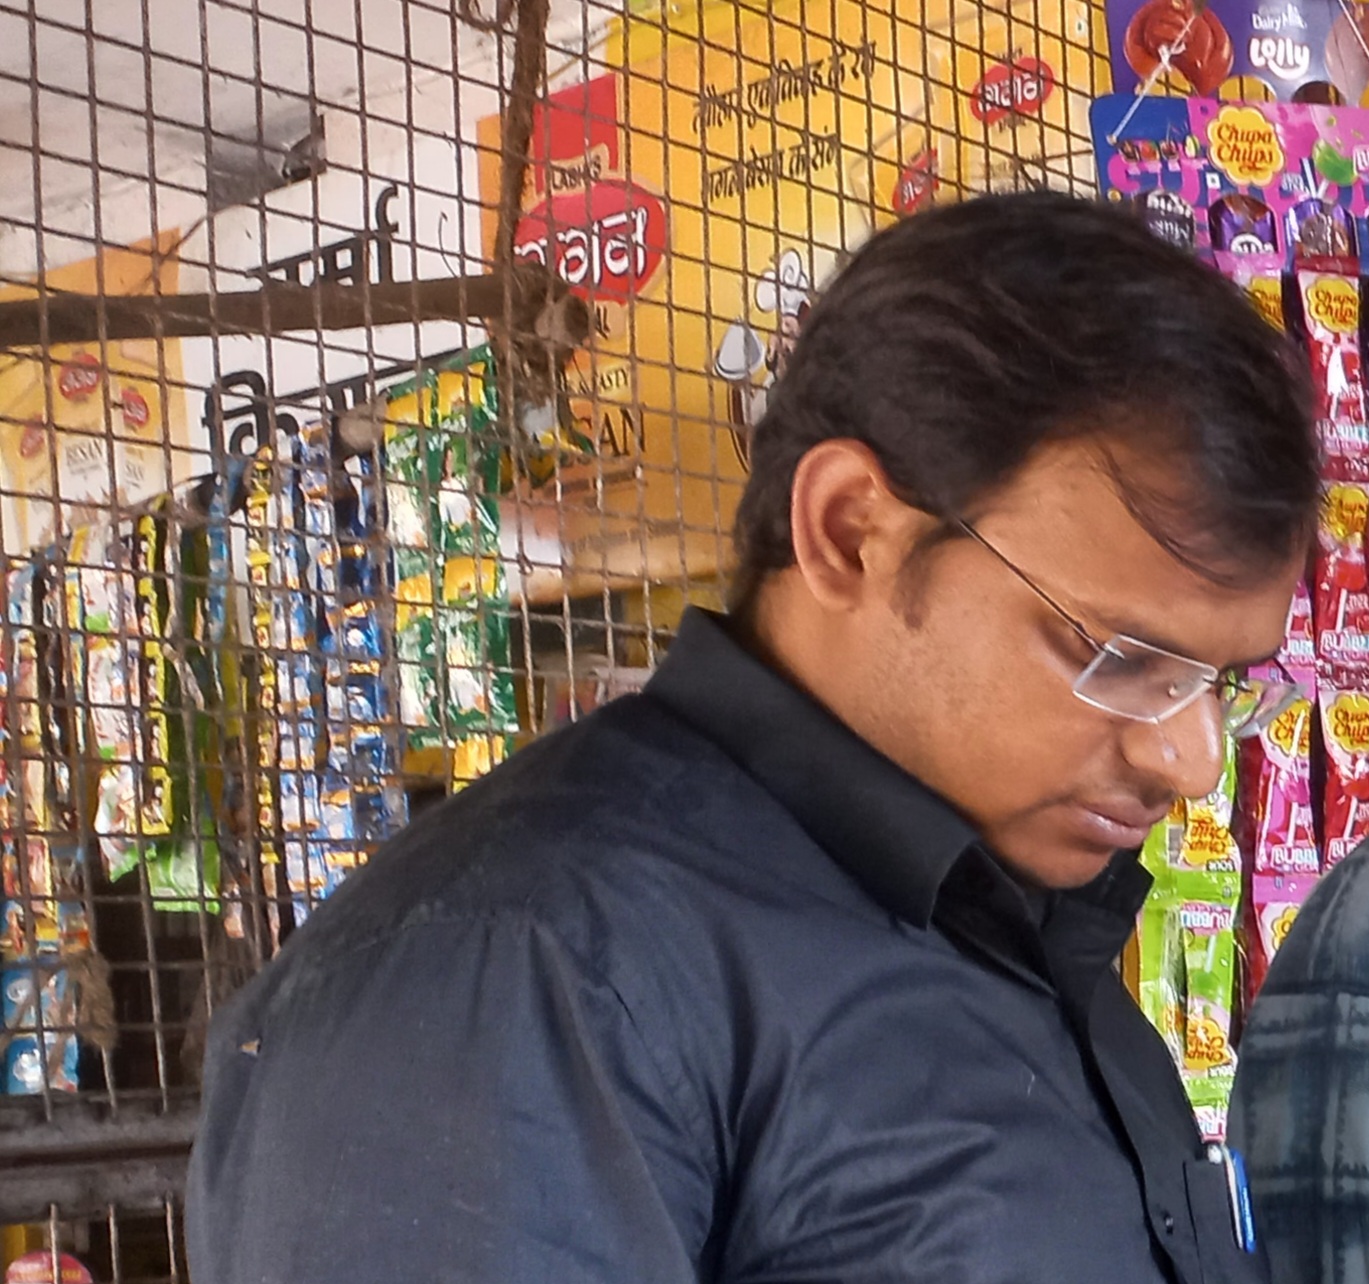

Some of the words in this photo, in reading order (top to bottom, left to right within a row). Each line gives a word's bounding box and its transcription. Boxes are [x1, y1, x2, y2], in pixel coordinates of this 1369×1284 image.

[1250, 37, 1309, 79] Lolly
[1216, 123, 1273, 146] Chupa
[1216, 146, 1274, 173] Chups
